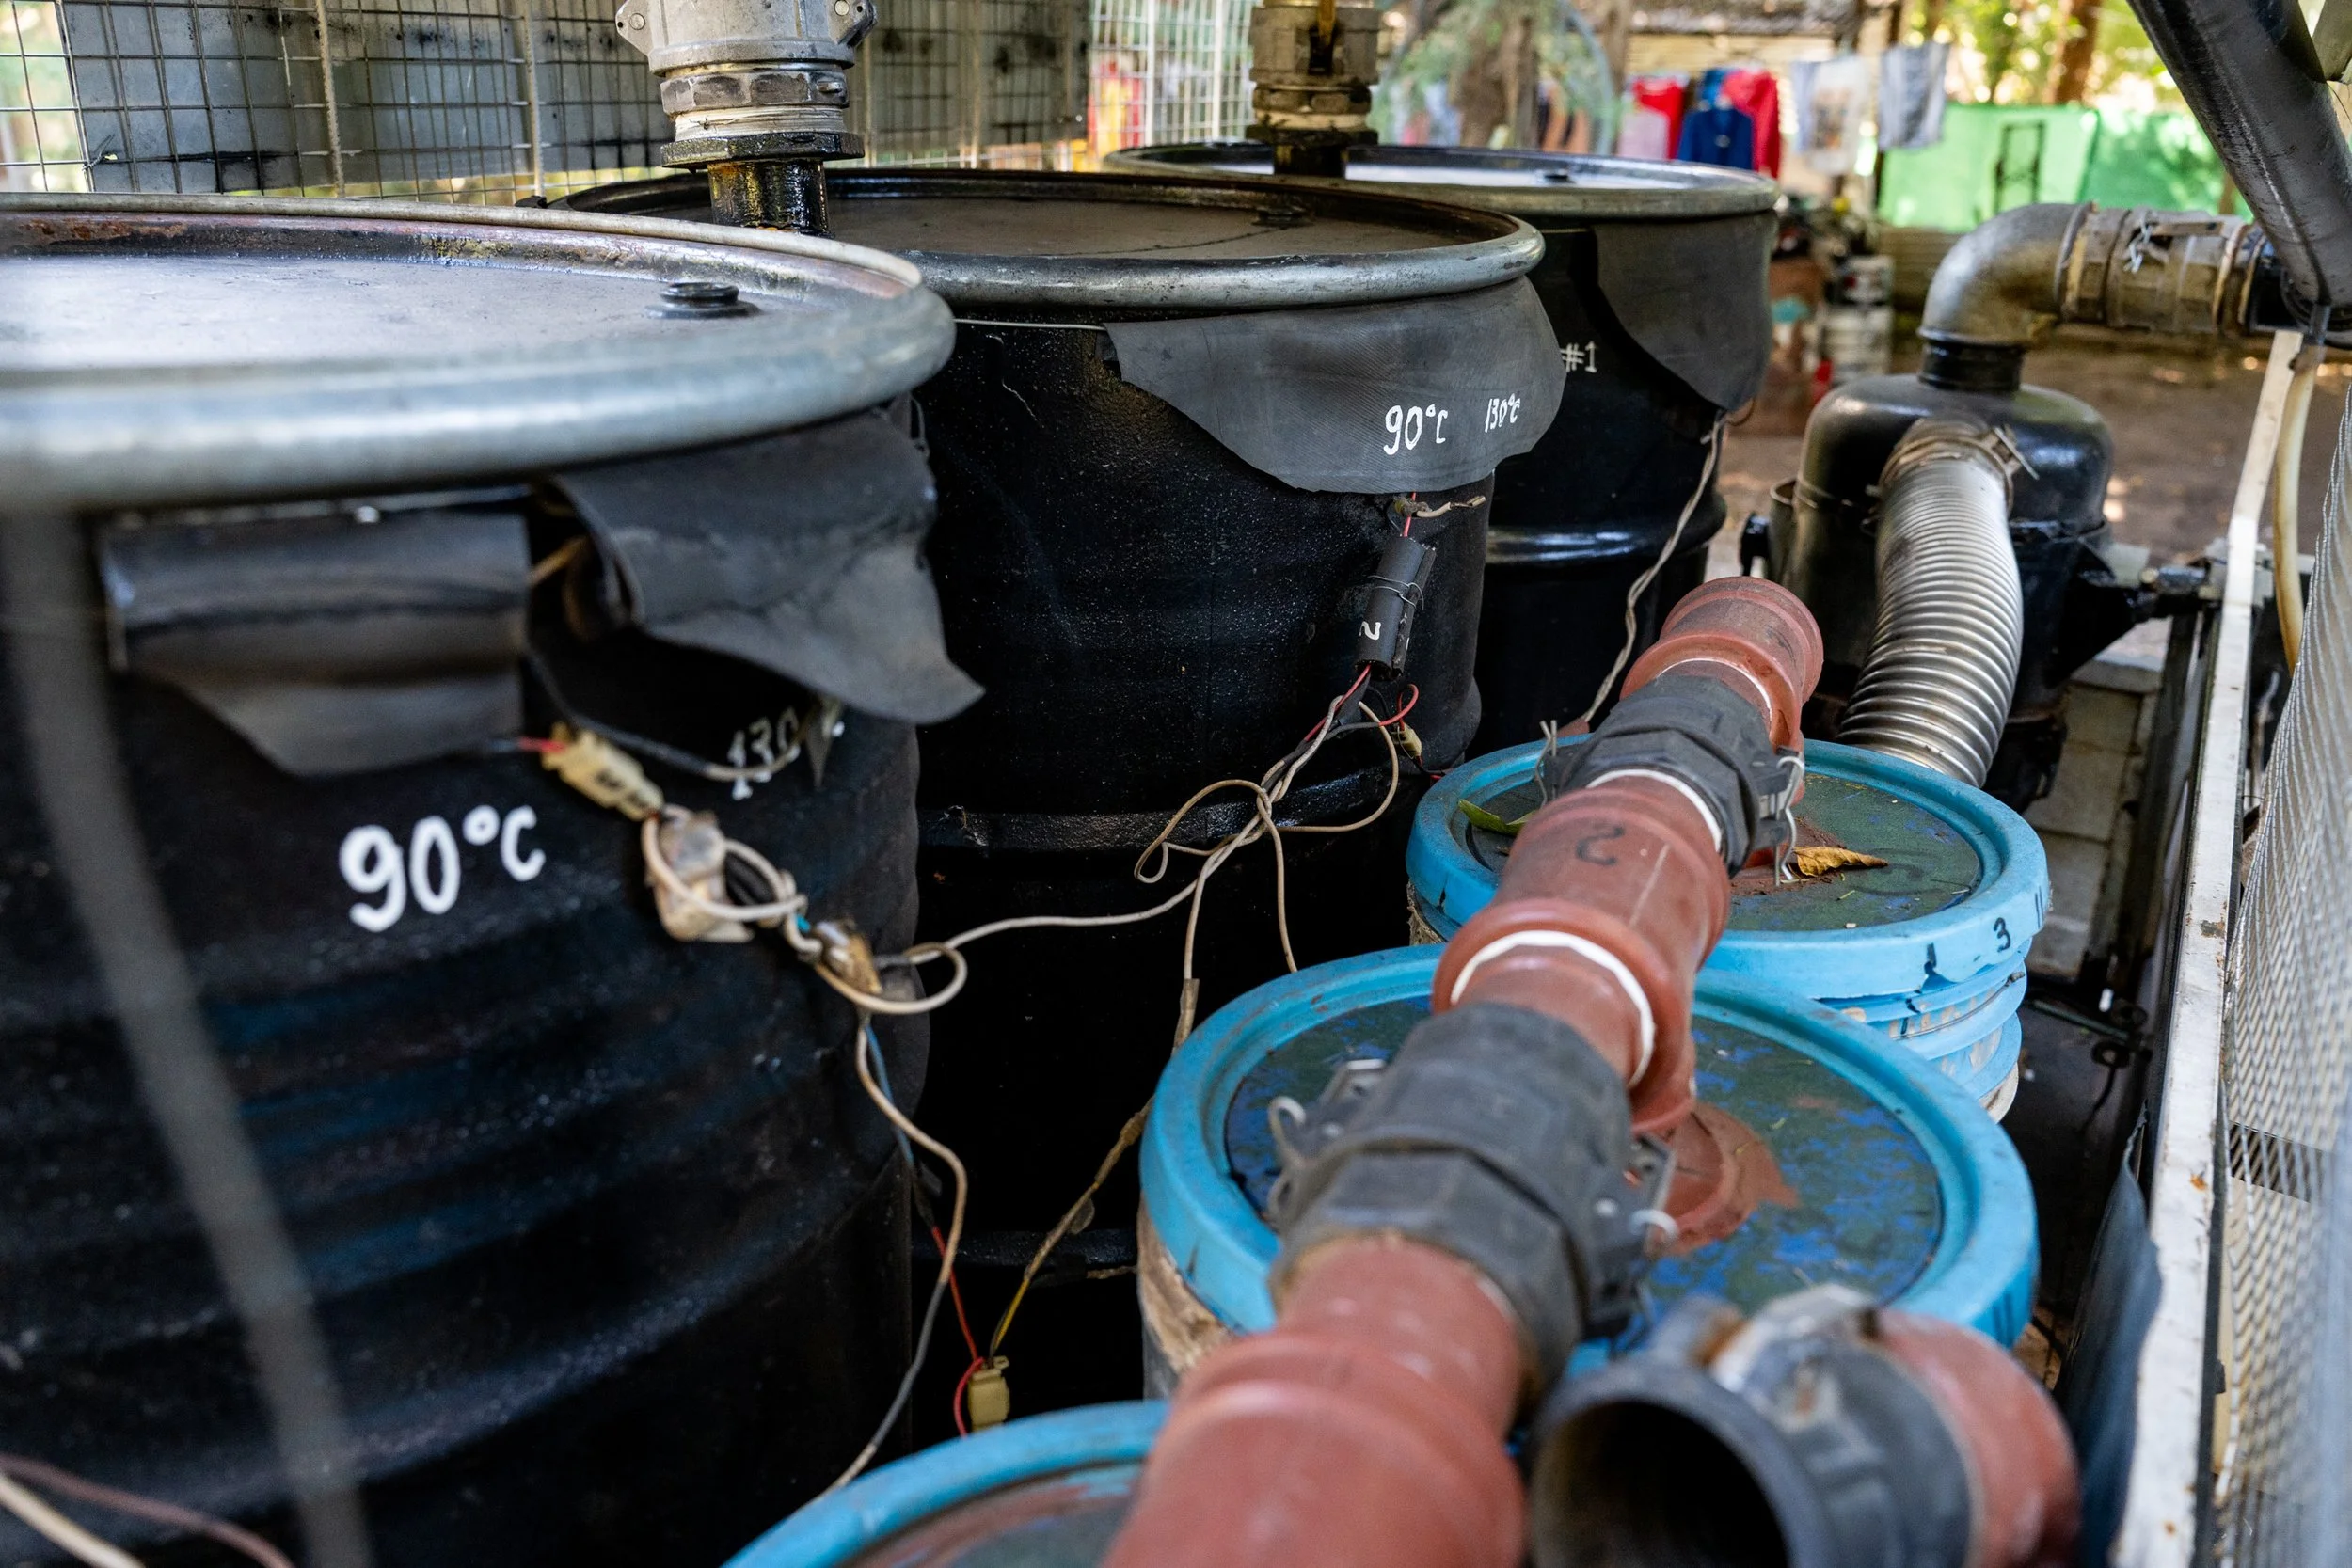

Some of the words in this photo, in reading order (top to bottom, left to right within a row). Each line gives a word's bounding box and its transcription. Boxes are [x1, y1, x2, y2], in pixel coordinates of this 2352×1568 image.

[1560, 341, 1598, 373] #1
[1383, 404, 1449, 455] 90°C
[339, 804, 547, 933] 90°C
[1993, 917, 2011, 954] 3
